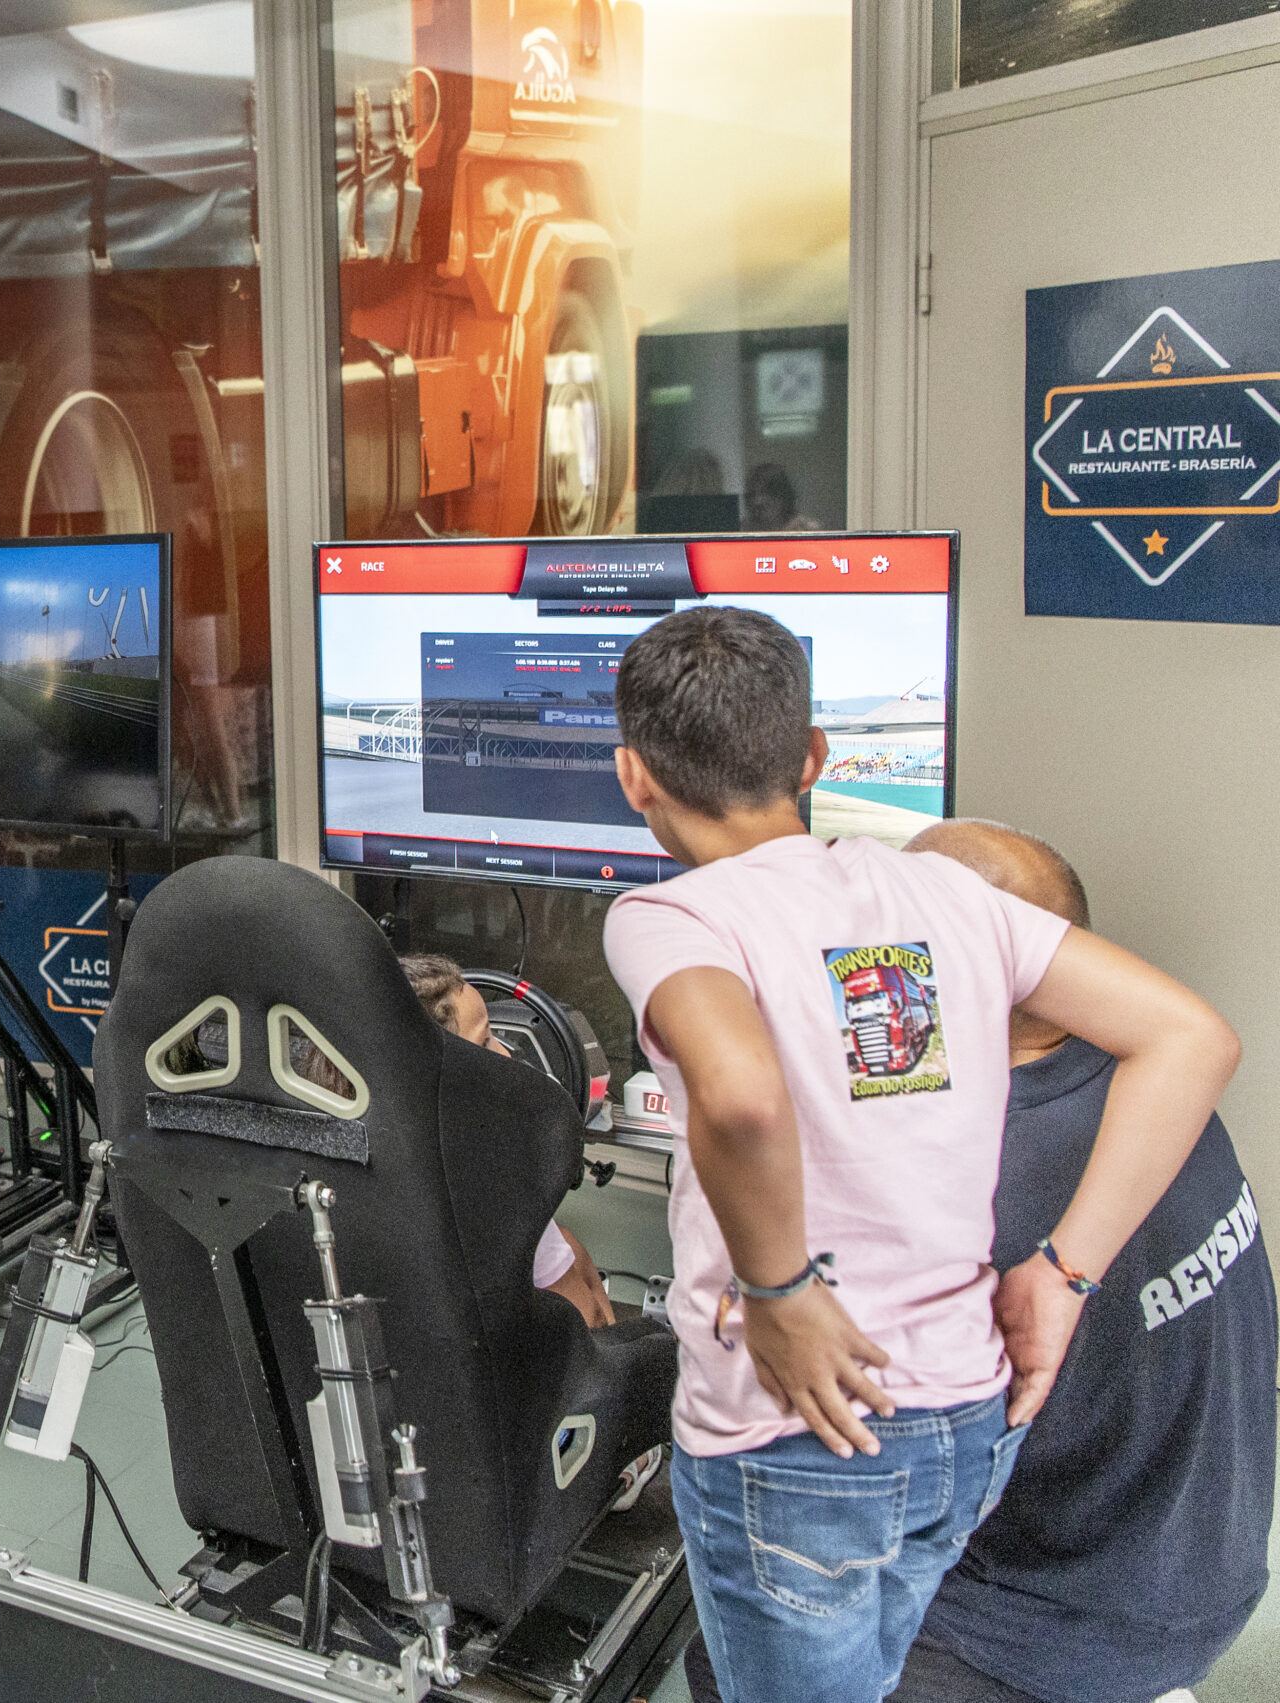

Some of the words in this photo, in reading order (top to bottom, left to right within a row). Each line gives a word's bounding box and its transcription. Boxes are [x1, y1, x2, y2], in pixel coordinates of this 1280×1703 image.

[1082, 429, 1115, 454] LA
[1120, 423, 1242, 453] CENTRAL
[1068, 459, 1170, 475] RESTAURANTE
[1178, 455, 1257, 472] BRASERÍA
[360, 561, 385, 571] RACE
[545, 561, 665, 573] AUTOMOBILISTA
[579, 604, 601, 613] 2/2
[605, 604, 632, 613] LAPS
[434, 638, 455, 646] DRIVER
[514, 639, 539, 647] SECTORS
[597, 640, 616, 649] CLASS
[407, 850, 428, 859] SESSION
[485, 856, 500, 865] NEXT
[500, 857, 523, 866] SESSION
[71, 957, 92, 975] LA
[826, 944, 933, 983] TRANSPORTES
